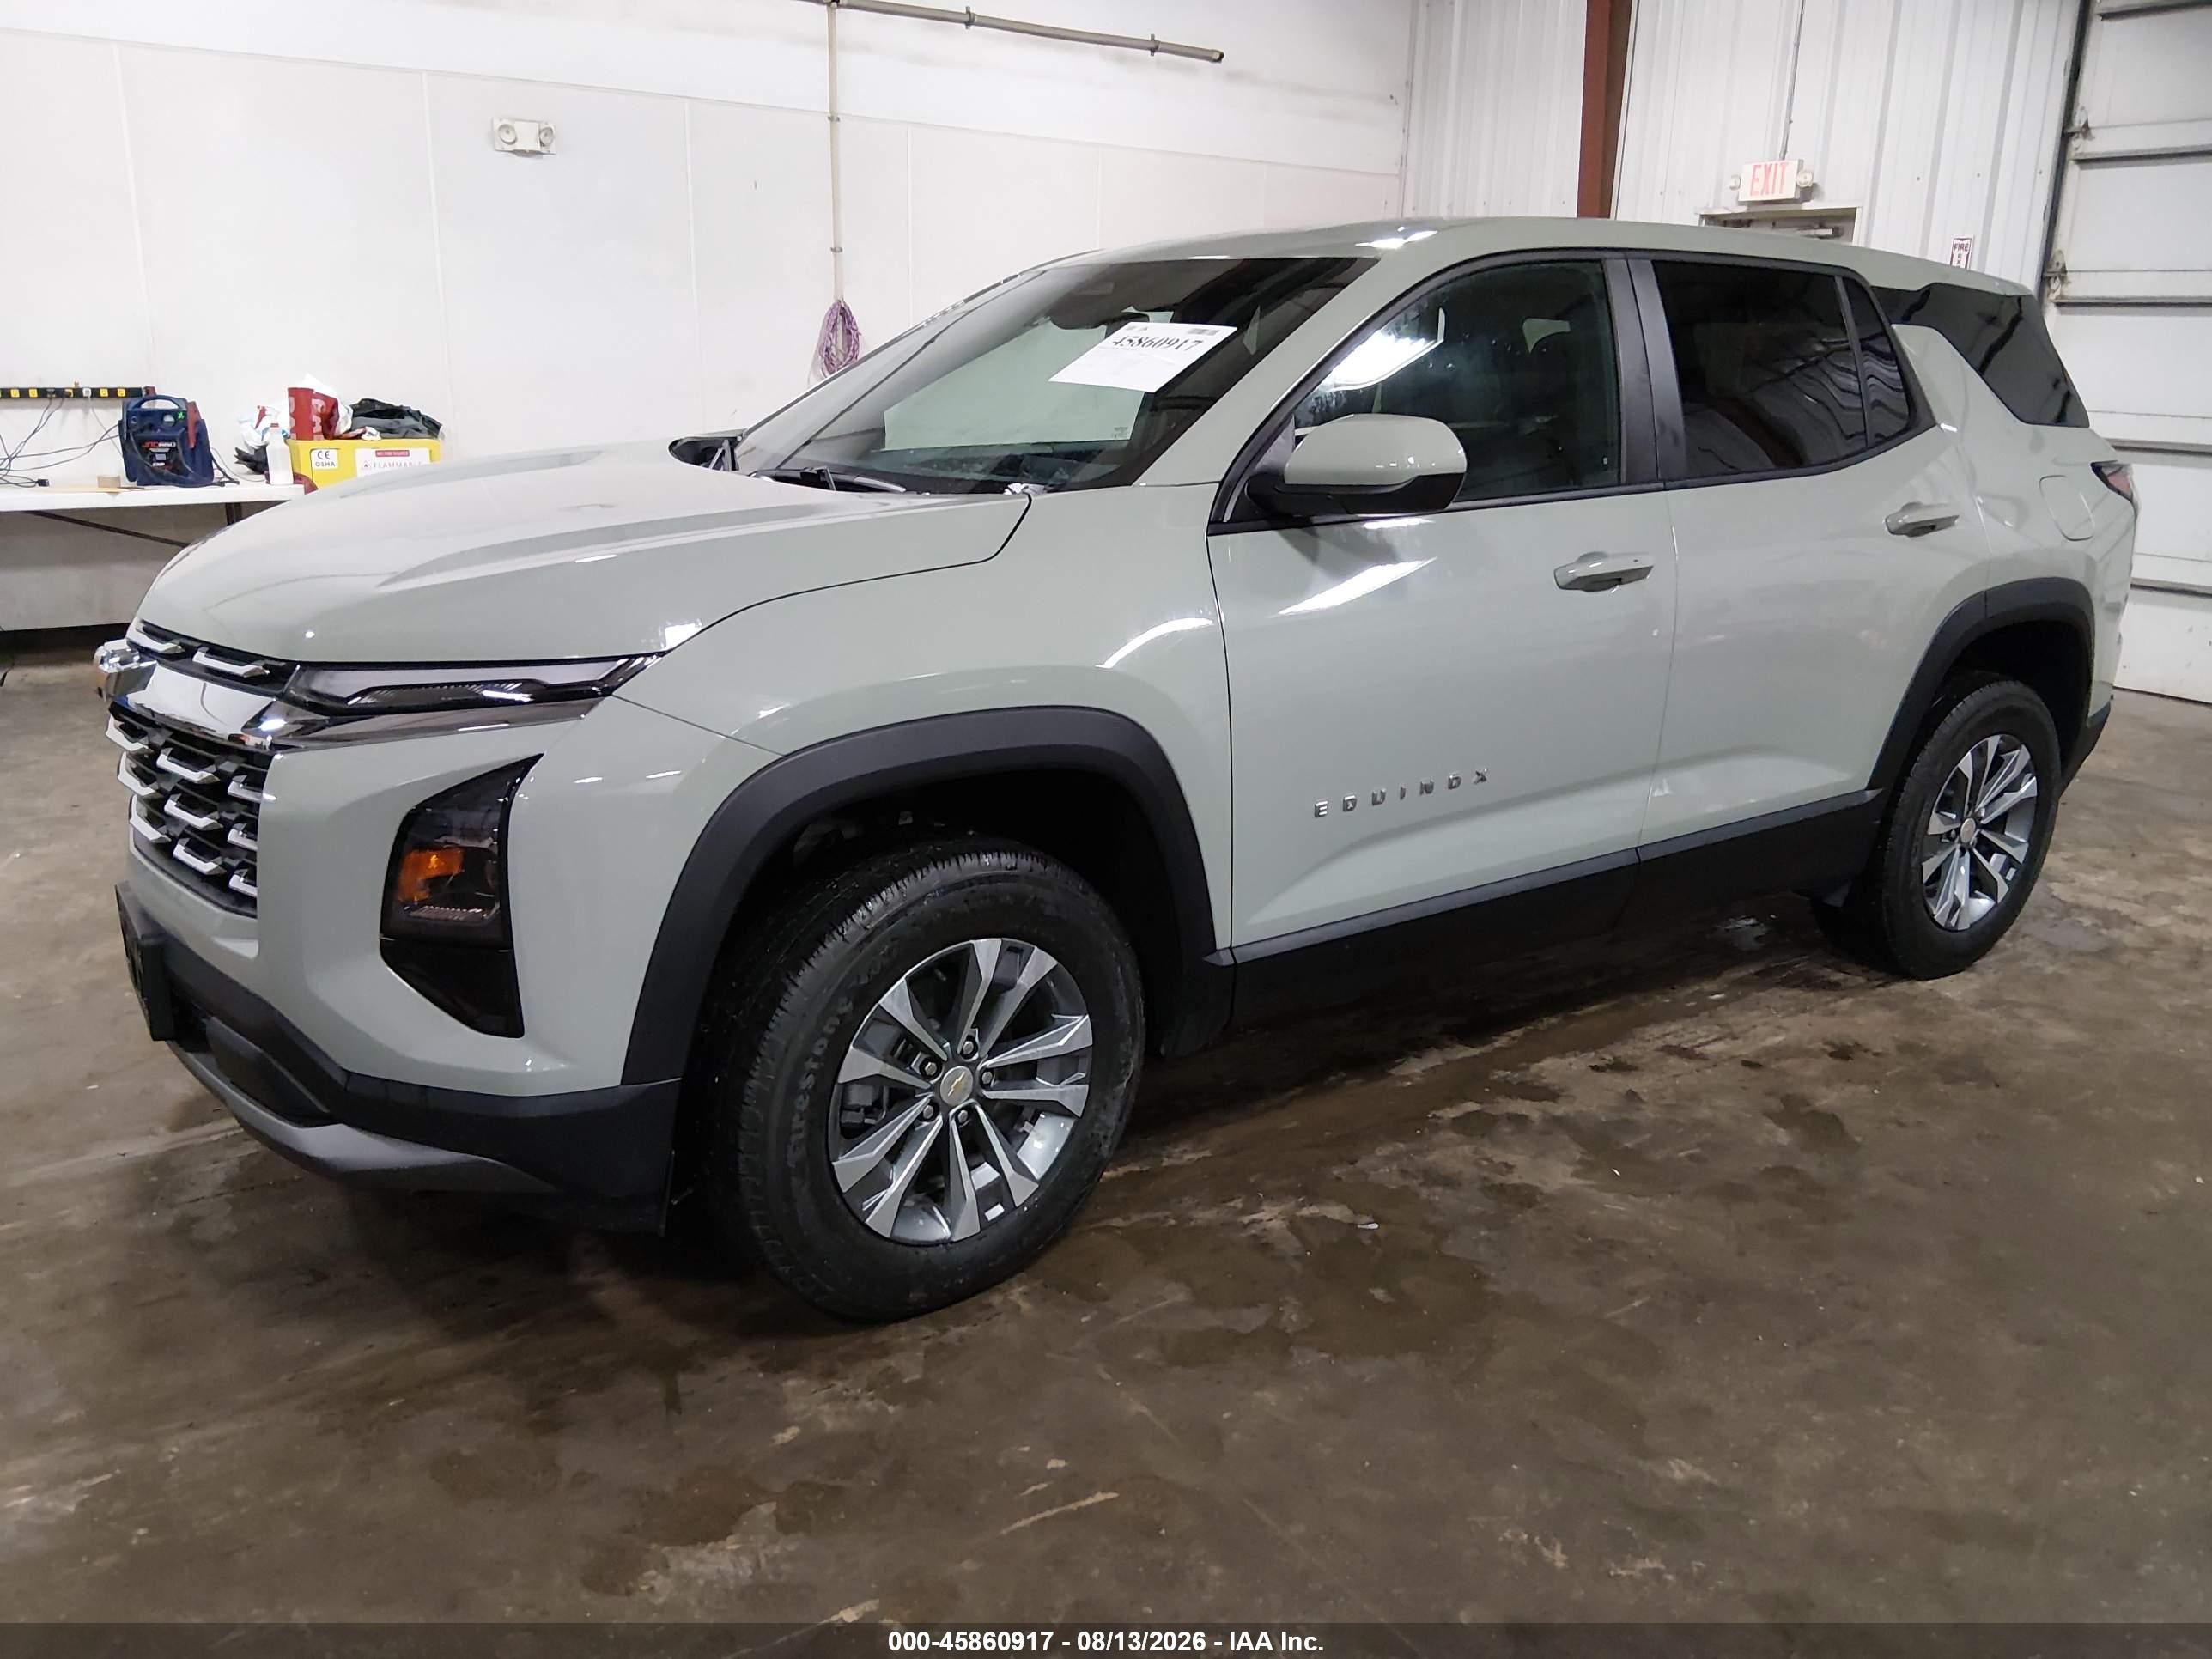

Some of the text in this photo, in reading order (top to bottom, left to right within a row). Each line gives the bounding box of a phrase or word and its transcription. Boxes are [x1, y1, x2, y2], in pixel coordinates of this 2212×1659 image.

[1750, 162, 1787, 196] EXIT
[1954, 242, 1969, 252] FIRE
[1112, 335, 1205, 351] 45860917
[1314, 768, 1488, 817] EQUINOX
